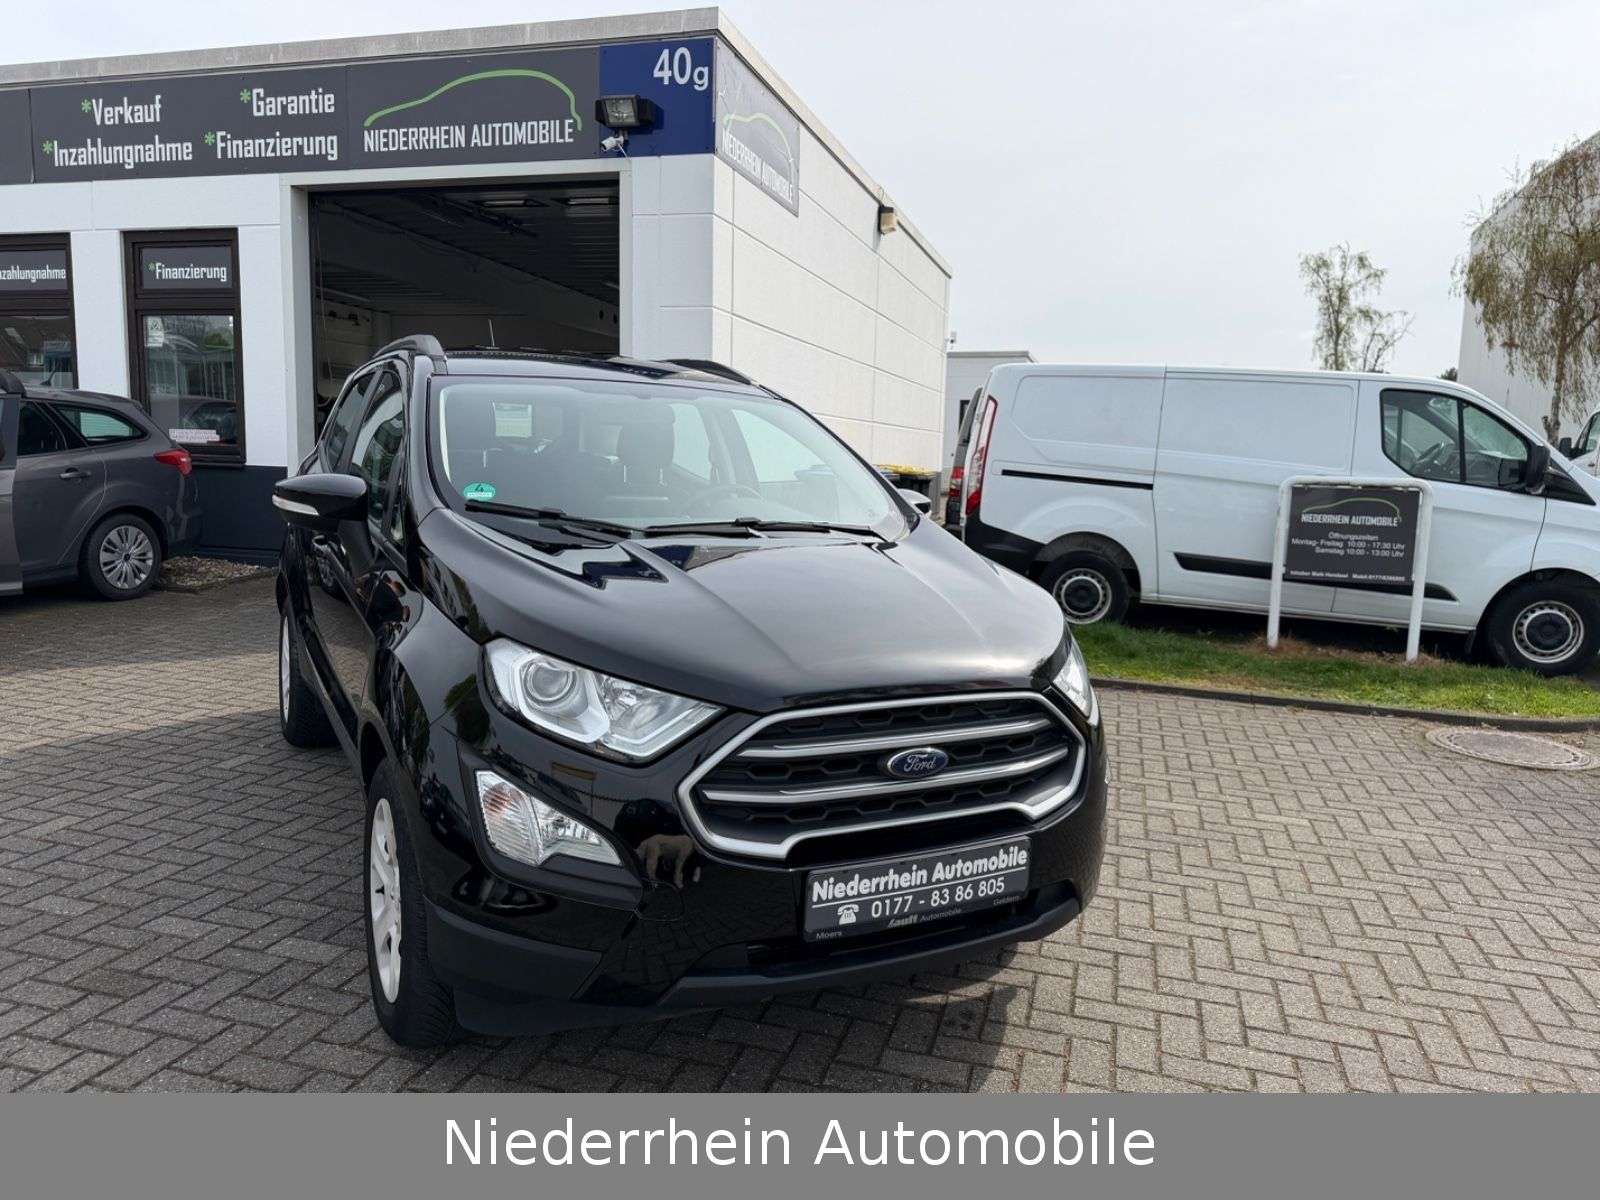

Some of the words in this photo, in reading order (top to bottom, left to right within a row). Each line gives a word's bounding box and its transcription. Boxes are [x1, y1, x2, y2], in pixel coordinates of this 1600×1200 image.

[653, 47, 709, 90] 40g
[363, 124, 466, 153] NIEDERRHEIN
[470, 119, 575, 147] AUTOMOBILE
[722, 127, 761, 179] NIEDERRHEIN
[1301, 513, 1349, 524] NIEDERRHEIN
[1350, 515, 1398, 527] AUTOMOBILE
[1315, 546, 1345, 556] Samstag
[1391, 549, 1405, 558] Uhr
[1320, 539, 1344, 548] Freitag
[1392, 542, 1405, 550] Uhr
[903, 753, 936, 773] Ford
[812, 864, 927, 902] Niederrhein
[931, 846, 1028, 882] Automobile
[871, 895, 913, 918] 0177
[931, 888, 950, 907] 83
[955, 883, 974, 902] 86
[978, 877, 1005, 897] 805
